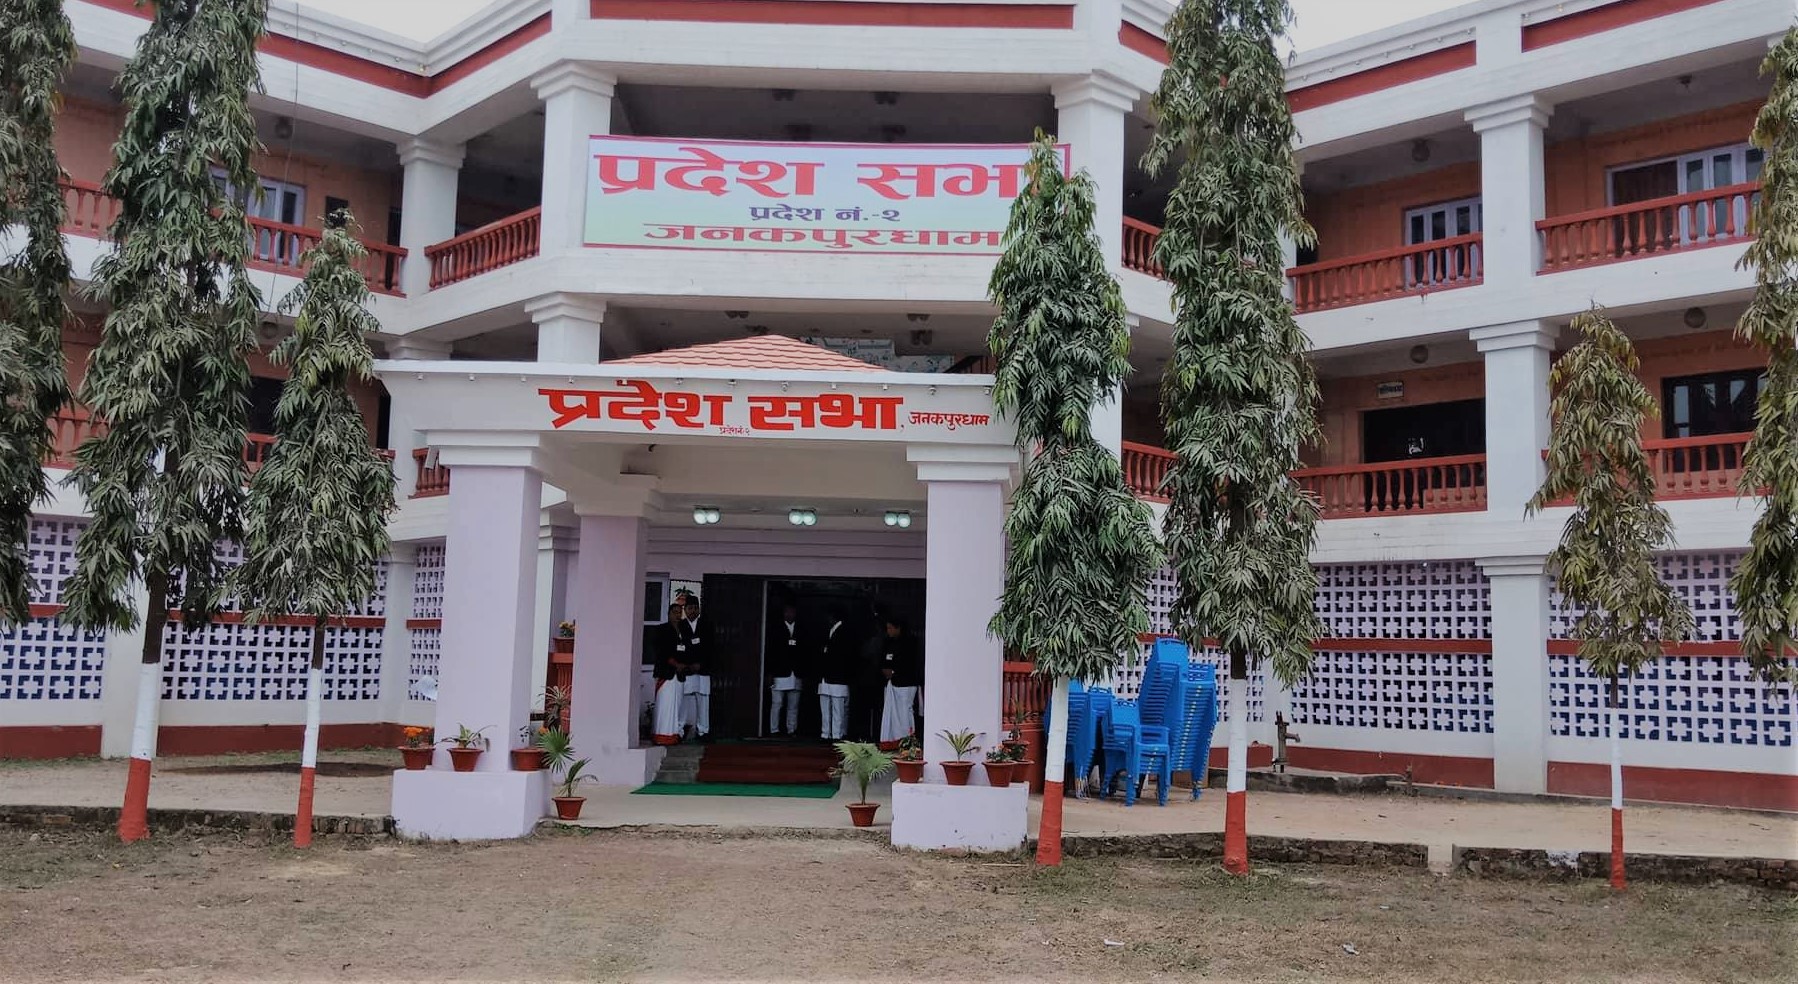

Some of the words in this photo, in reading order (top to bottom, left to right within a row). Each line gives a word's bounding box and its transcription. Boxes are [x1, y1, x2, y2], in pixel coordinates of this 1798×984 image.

[593, 147, 825, 199] प्रदेश
[856, 163, 1042, 200] सभ
[749, 203, 825, 222] प्रदेश
[538, 379, 732, 430] प्रदेश
[908, 411, 990, 431] जनकपुरधाम
